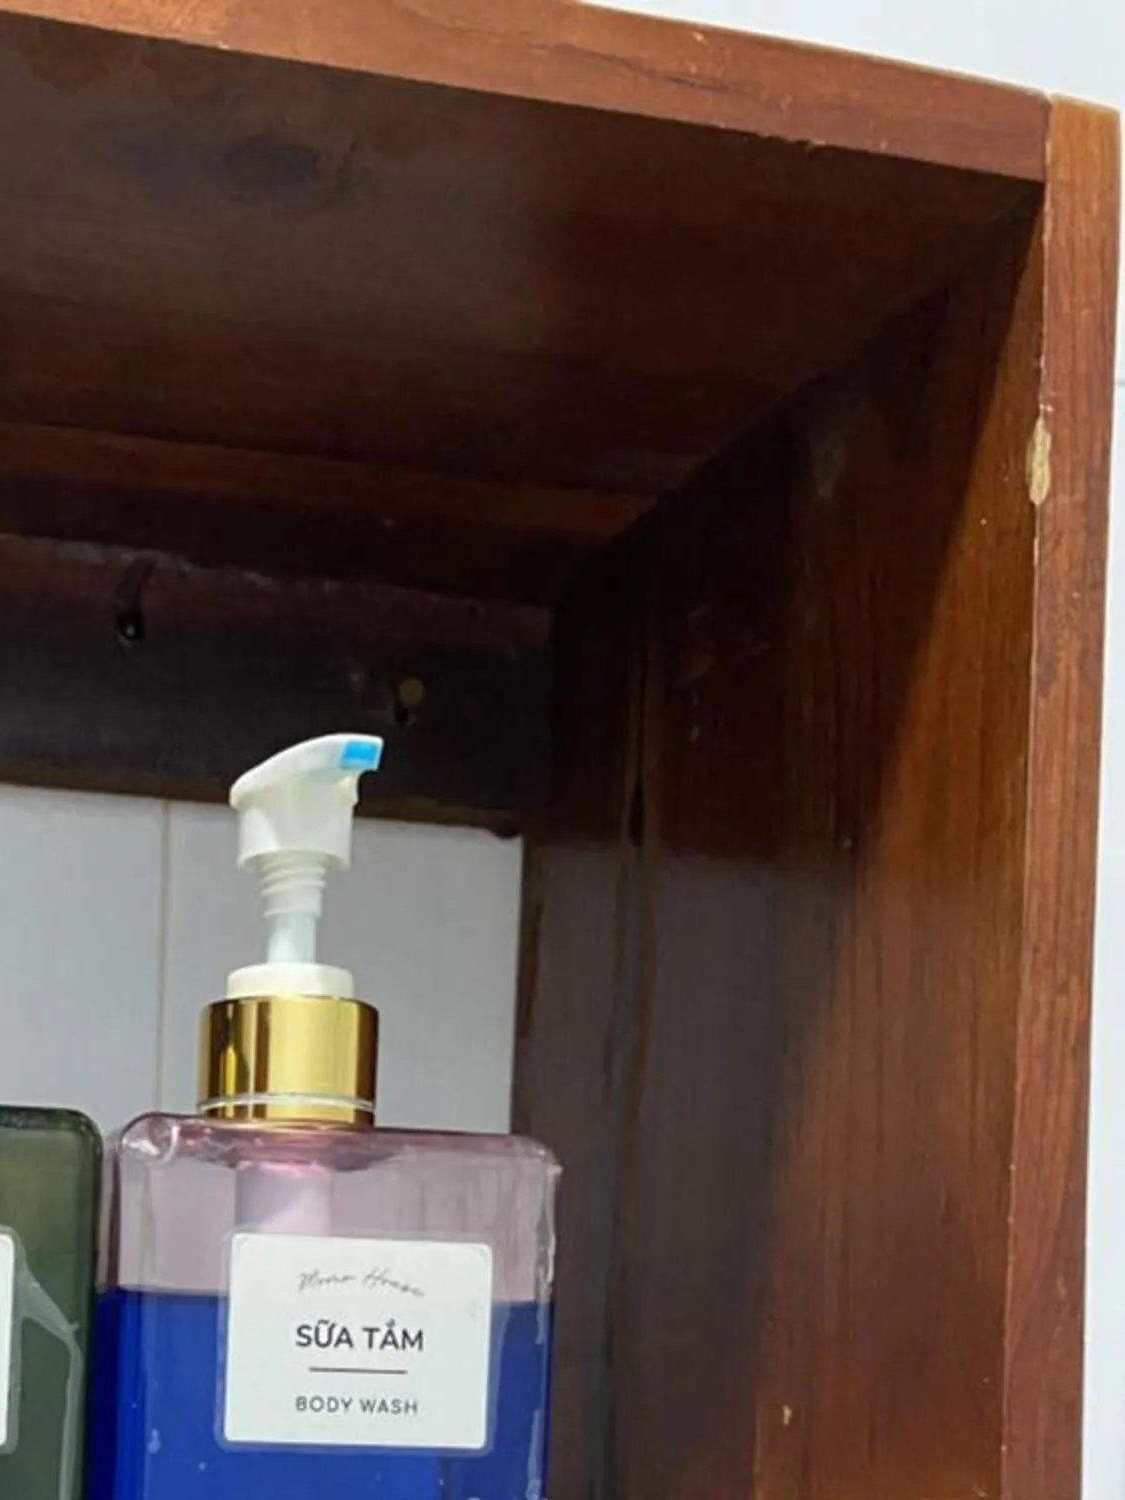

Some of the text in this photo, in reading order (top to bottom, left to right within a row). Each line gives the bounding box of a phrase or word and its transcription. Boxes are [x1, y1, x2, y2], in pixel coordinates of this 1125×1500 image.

[295, 1317, 424, 1351] SỮA TẮM
[295, 1395, 418, 1415] BODY WASH
